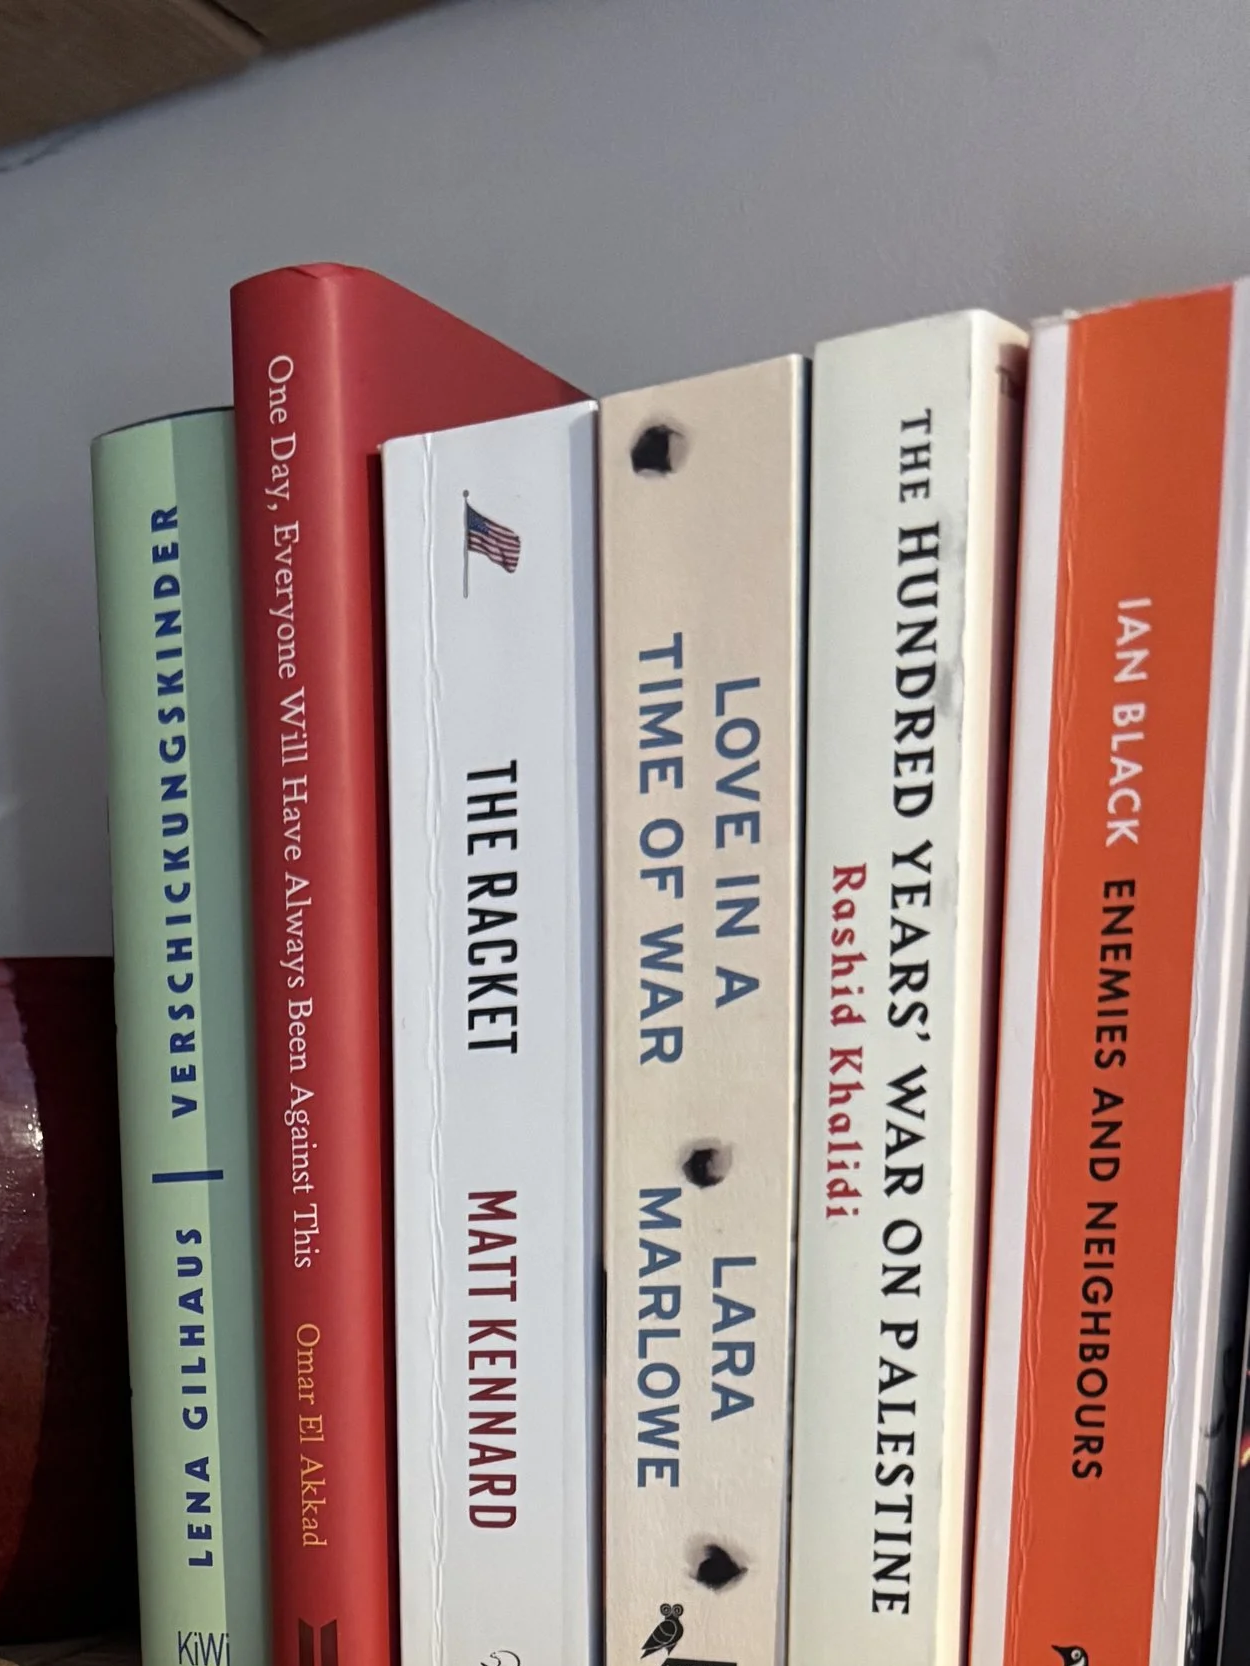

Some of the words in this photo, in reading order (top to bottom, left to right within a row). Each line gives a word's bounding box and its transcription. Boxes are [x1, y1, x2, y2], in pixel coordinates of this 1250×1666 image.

[267, 354, 295, 424] One
[265, 437, 297, 515] Day,
[898, 408, 933, 505] THE
[269, 522, 301, 680] Everyone
[1113, 597, 1153, 683] IAN
[280, 689, 309, 762] Will
[638, 631, 684, 796] TIME
[893, 521, 941, 818] HUNDRED
[151, 506, 199, 1120] VERSCHICKUNGSKINDER
[281, 776, 308, 861] Have
[467, 759, 517, 857] THE
[715, 676, 760, 850] LOVE
[1105, 703, 1147, 848] BLACK
[638, 818, 684, 900] OF
[715, 873, 760, 940] IN
[282, 872, 313, 988] Always
[467, 870, 517, 1054] RACKET
[829, 862, 868, 1028] Rashid
[887, 840, 934, 1043] YEARS'
[1093, 879, 1137, 1070] ENEMIES
[286, 999, 315, 1071] Been
[639, 923, 684, 1066] WAR
[714, 967, 760, 1010] A
[285, 1083, 319, 1195] Against
[825, 1045, 865, 1220] Khalidi
[883, 1064, 928, 1199] WAR
[1088, 1087, 1125, 1182] AND
[292, 1204, 319, 1268] This
[467, 1190, 517, 1303] MATT
[881, 1219, 924, 1298] ON
[175, 1228, 209, 1431] GILHAUS
[295, 1322, 323, 1405] Omar
[637, 1186, 683, 1490] MARLOWE
[711, 1255, 757, 1423] LARA
[1071, 1201, 1119, 1481] NEIGHBOURS
[297, 1413, 323, 1445] El
[467, 1318, 517, 1530] KENNARD
[871, 1319, 920, 1615] PALESTINE
[187, 1455, 214, 1568] LENA
[298, 1456, 326, 1549] Akkad
